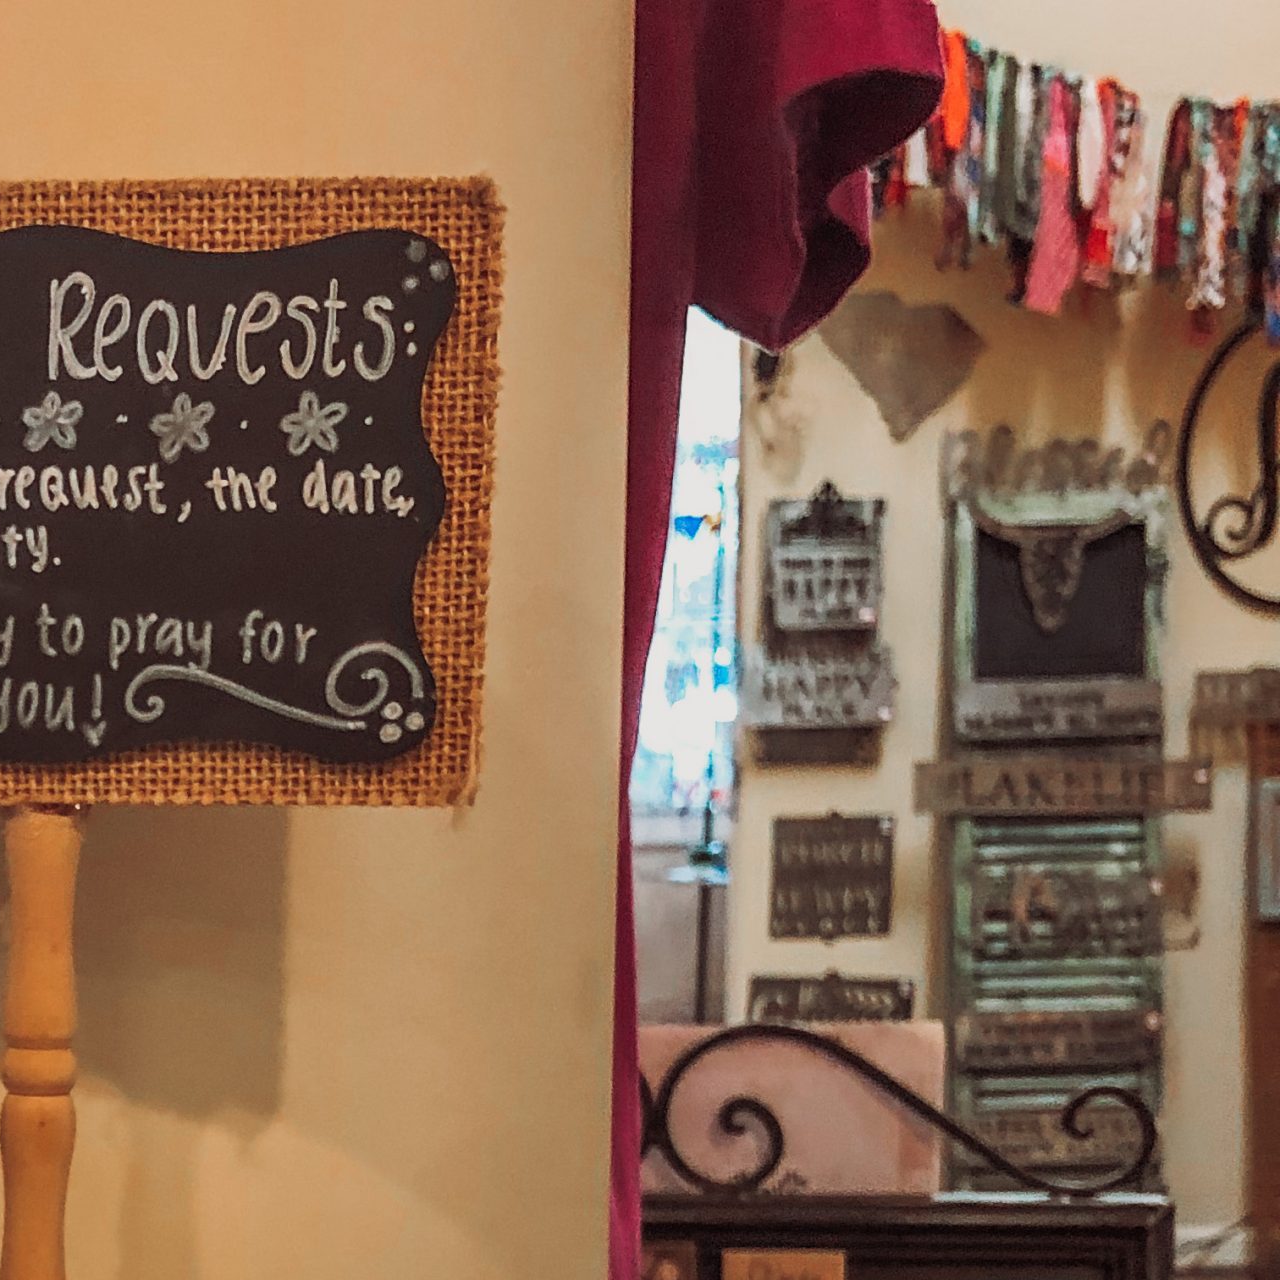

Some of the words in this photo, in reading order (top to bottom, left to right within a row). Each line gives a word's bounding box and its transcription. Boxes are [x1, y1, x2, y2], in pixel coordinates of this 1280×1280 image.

[205, 466, 278, 512] the
[37, 603, 84, 656] to
[109, 613, 213, 669] pray
[238, 610, 317, 665] for
